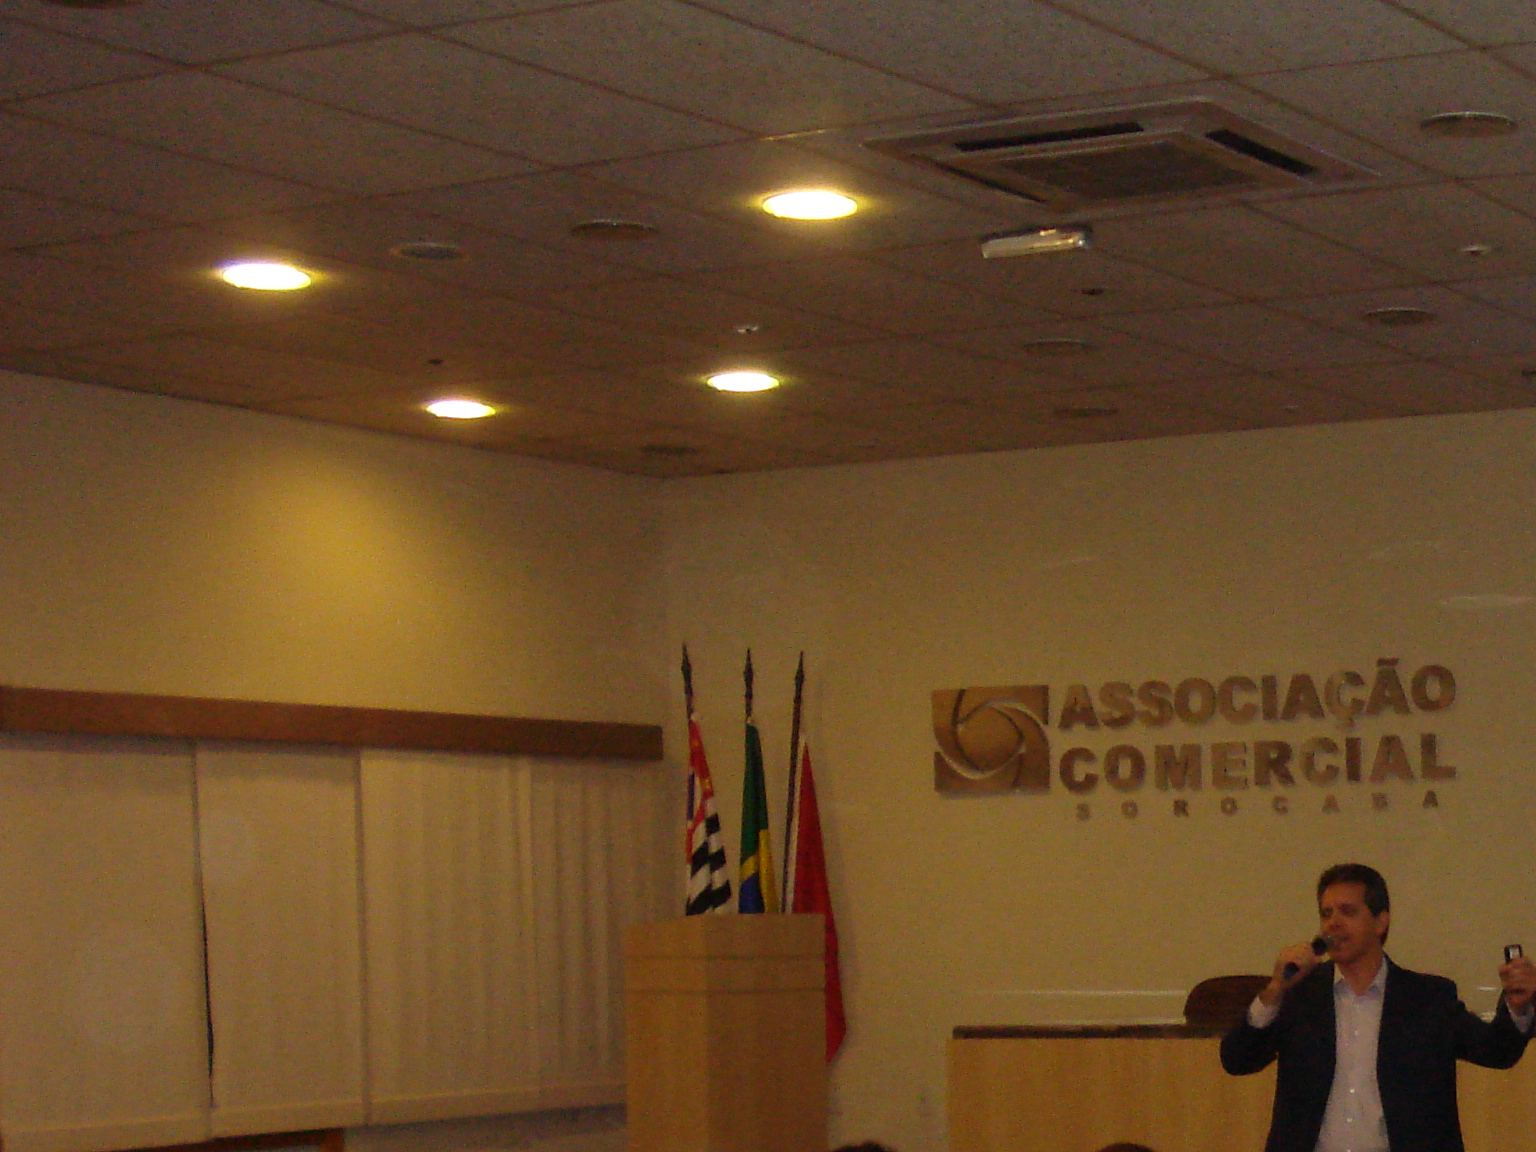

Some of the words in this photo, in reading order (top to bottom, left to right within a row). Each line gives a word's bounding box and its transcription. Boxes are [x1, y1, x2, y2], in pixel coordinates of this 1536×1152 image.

[1058, 658, 1457, 730] ASSOCIAÇÃO
[1059, 733, 1457, 793] COMERCIAL
[1075, 790, 1440, 820] SOROCABA
